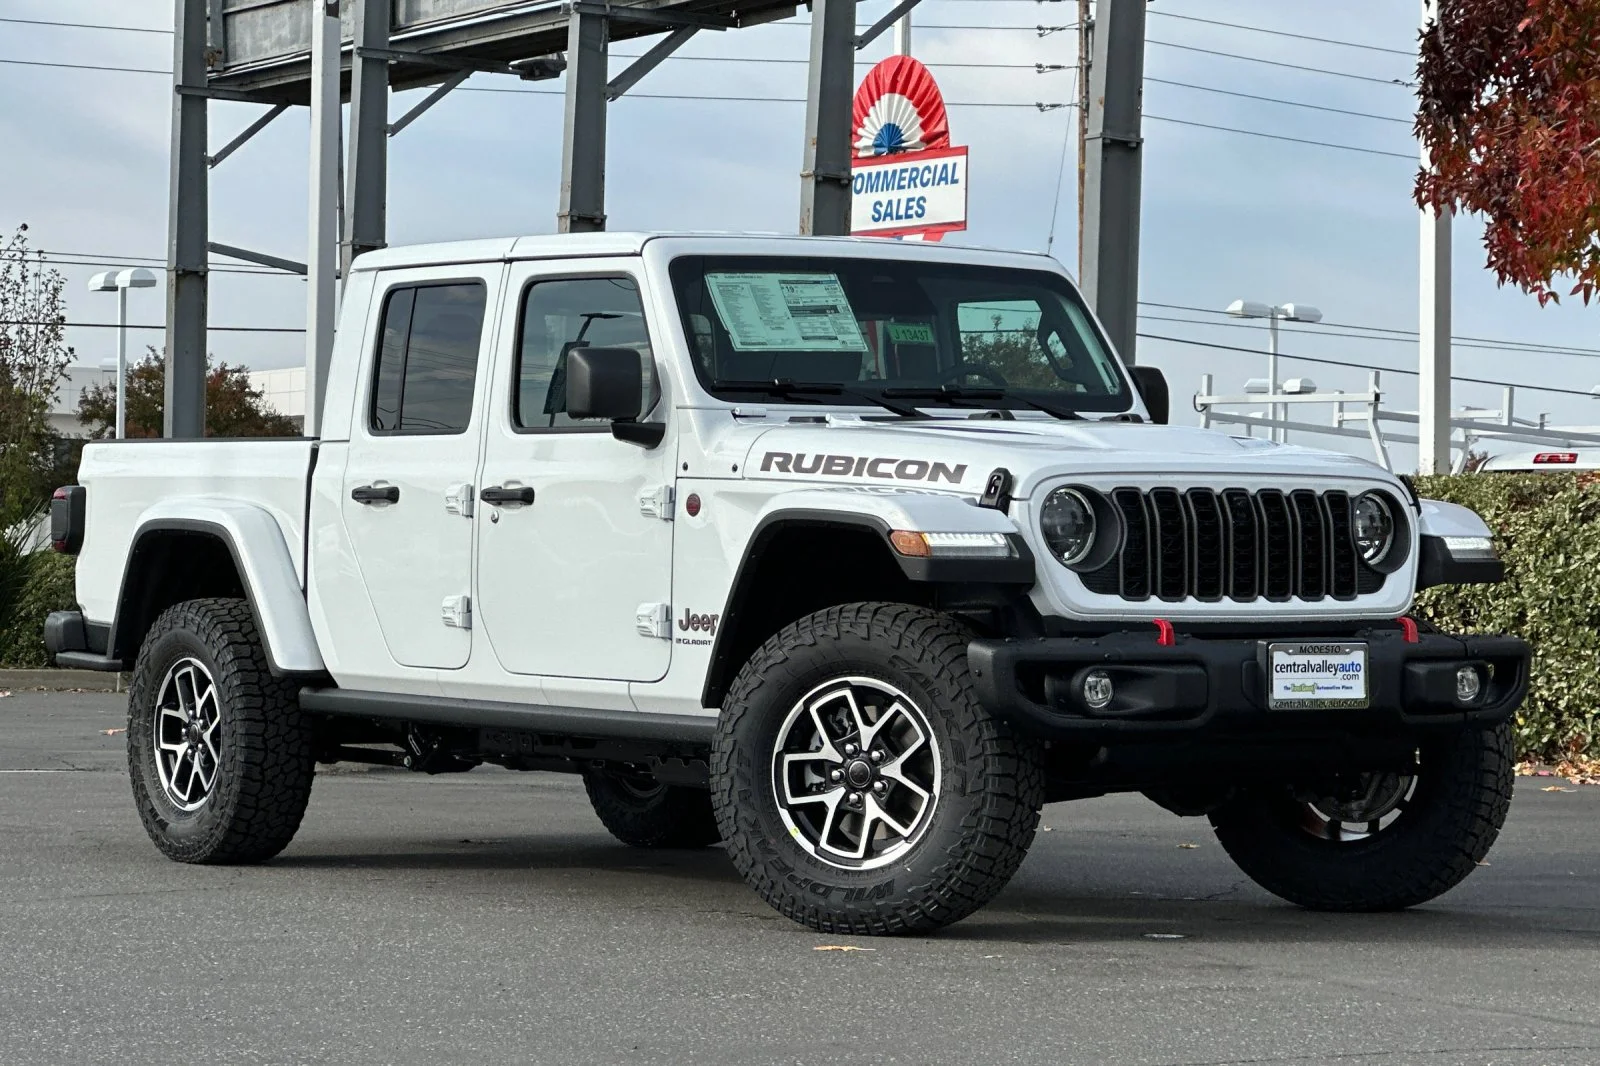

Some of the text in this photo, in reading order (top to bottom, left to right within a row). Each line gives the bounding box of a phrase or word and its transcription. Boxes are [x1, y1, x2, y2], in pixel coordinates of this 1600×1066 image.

[853, 162, 959, 194] OMMERCIAL
[871, 196, 927, 222] SALES
[760, 451, 968, 484] RUBICON
[678, 608, 719, 636] Jeep
[682, 638, 712, 646] GLADIAT
[1299, 645, 1341, 654] MODESTO
[1275, 660, 1362, 676] centralvalleyauto
[1340, 673, 1360, 681] .com
